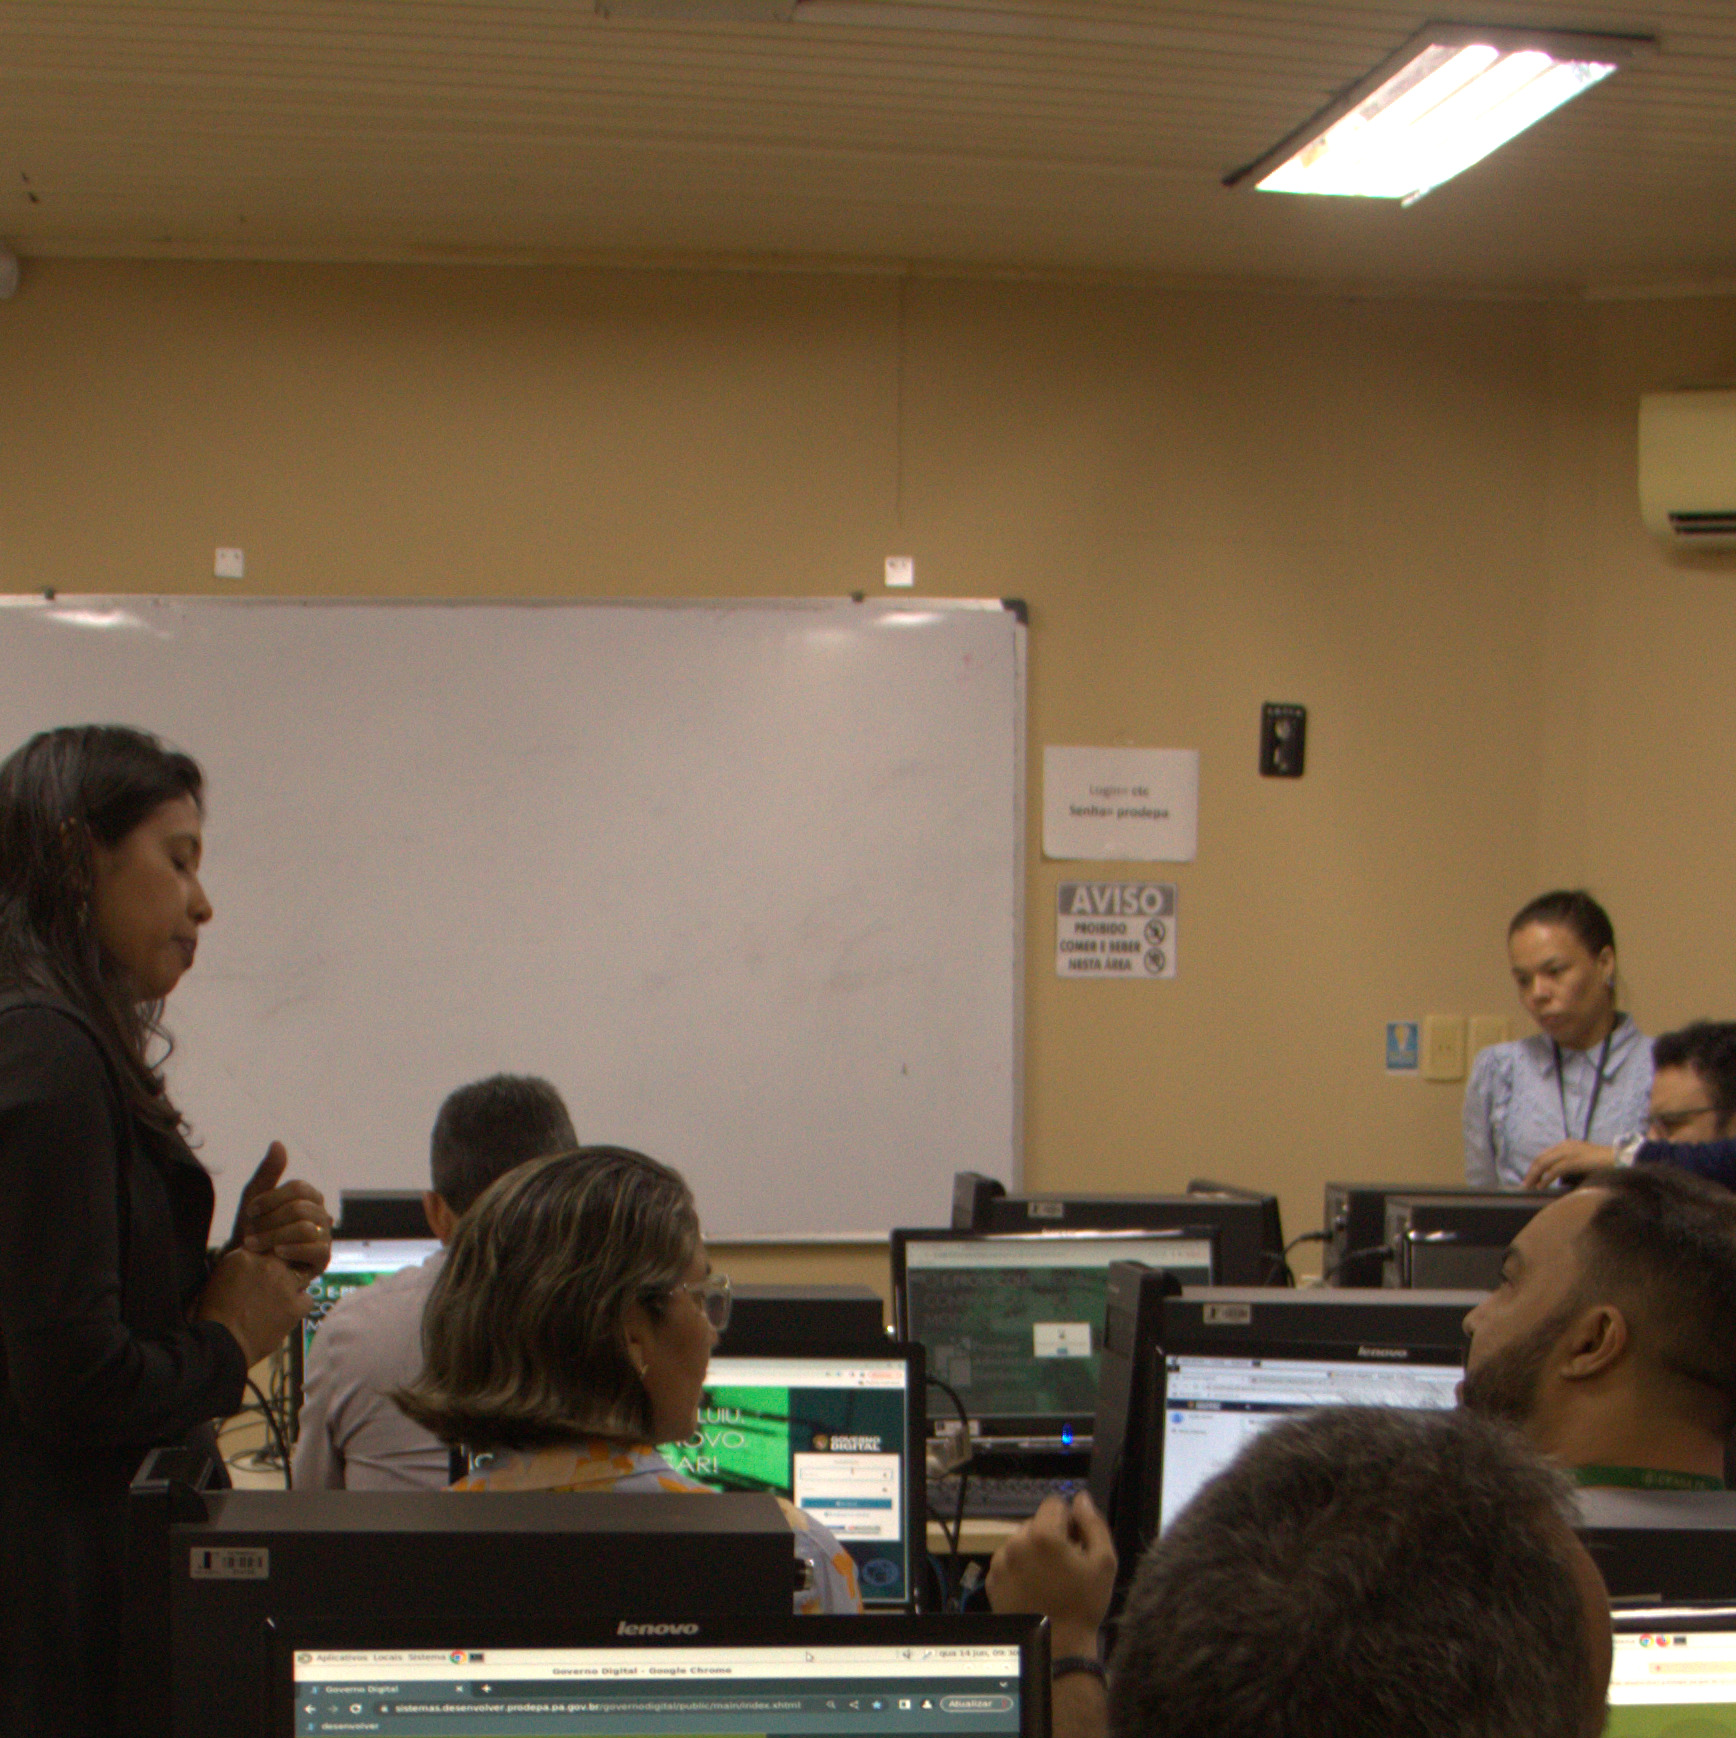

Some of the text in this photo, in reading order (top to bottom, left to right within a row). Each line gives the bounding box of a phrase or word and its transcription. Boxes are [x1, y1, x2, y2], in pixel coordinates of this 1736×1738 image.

[1070, 885, 1165, 915] AVISO
[1074, 922, 1127, 935] PROIBIDO
[1060, 940, 1141, 953] COMER E BEBER
[1068, 958, 1101, 970] NESTA
[697, 1407, 745, 1425] LUIU.
[616, 1620, 700, 1637] lenovo
[316, 1653, 368, 1663] Aplicativos
[373, 1653, 403, 1662] Locais
[408, 1652, 446, 1662] Sistema
[552, 1666, 732, 1676] Governo Digital Google Chrome
[325, 1684, 399, 1695] Governo Digital
[948, 1699, 993, 1709] Atualizar
[321, 1722, 379, 1731] desenvolver
